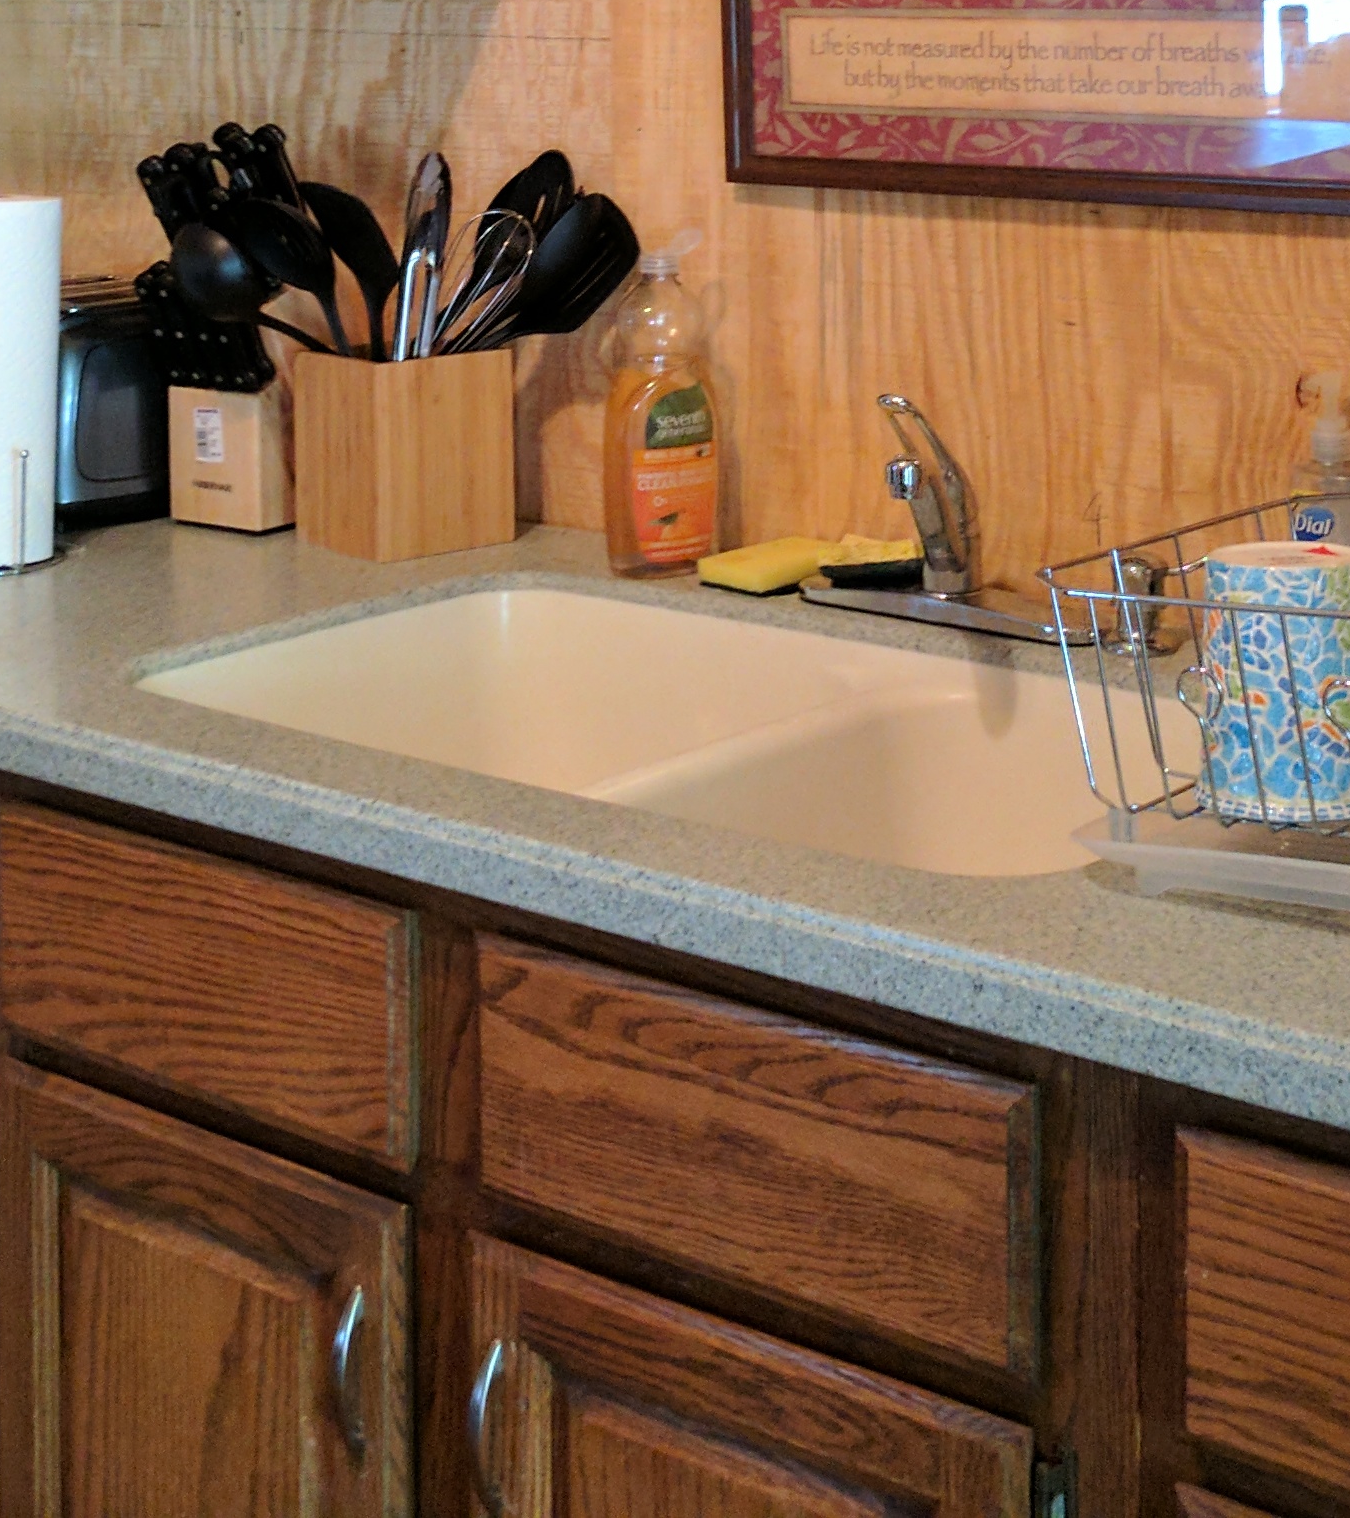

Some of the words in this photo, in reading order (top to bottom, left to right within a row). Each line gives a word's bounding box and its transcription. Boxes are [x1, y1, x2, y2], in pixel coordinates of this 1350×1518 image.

[810, 28, 843, 56] Life
[846, 34, 860, 56] is
[864, 36, 894, 57] not
[897, 30, 985, 59] measured
[989, 30, 1014, 70] by
[1017, 31, 1049, 60] the
[1053, 31, 1127, 61] number
[1131, 32, 1156, 62] of
[1159, 32, 1241, 63] breaths
[843, 58, 874, 88] but
[877, 60, 901, 99] by
[904, 60, 934, 90] the
[937, 73, 1020, 92] moments
[1023, 63, 1067, 94] that
[1068, 64, 1112, 95] take
[1116, 79, 1153, 96] our
[1156, 65, 1225, 97] breath
[1294, 513, 1333, 536] Dial
